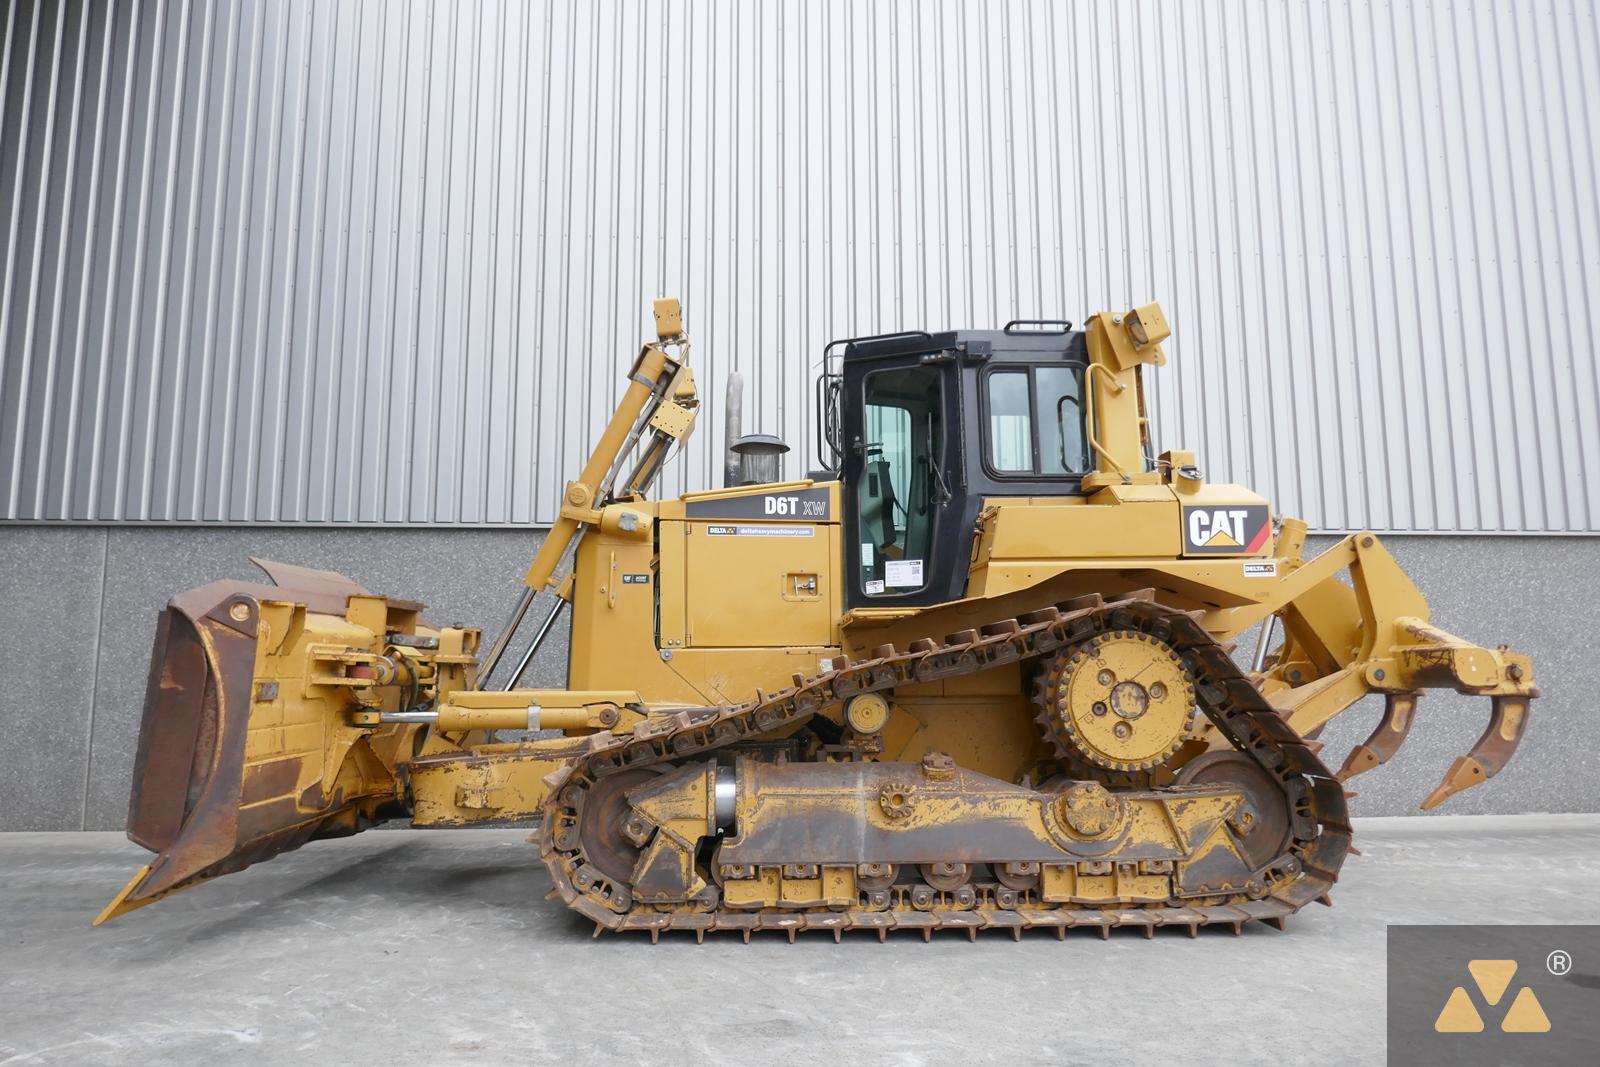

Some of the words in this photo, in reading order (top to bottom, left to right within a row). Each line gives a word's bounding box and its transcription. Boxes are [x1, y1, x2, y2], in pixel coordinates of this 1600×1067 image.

[765, 496, 799, 515] D6T
[802, 501, 826, 516] XW
[1189, 510, 1248, 546] CAT
